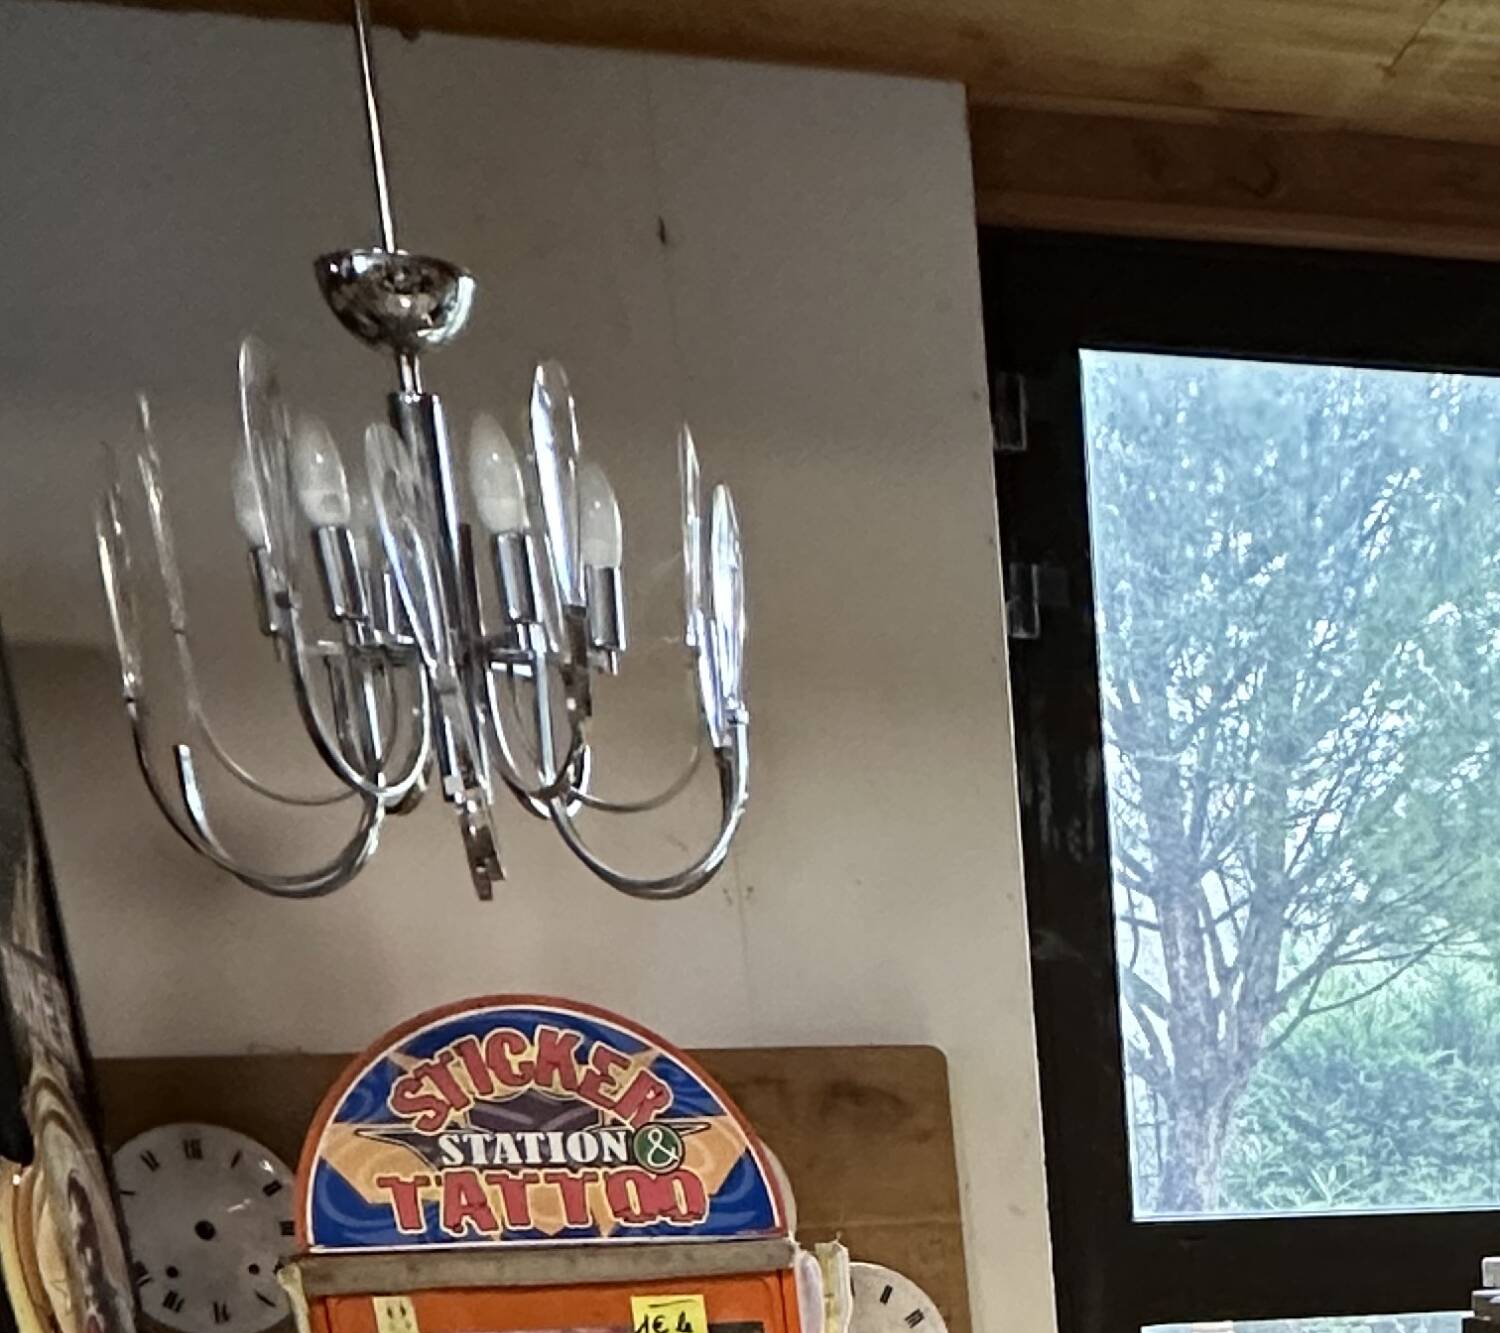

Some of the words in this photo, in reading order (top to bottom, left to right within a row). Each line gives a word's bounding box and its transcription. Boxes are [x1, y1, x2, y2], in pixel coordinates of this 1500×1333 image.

[388, 1024, 672, 1132] STICKER
[438, 1130, 627, 1167] STATION
[646, 1129, 681, 1167] &
[376, 1166, 710, 1237] TATTOO
